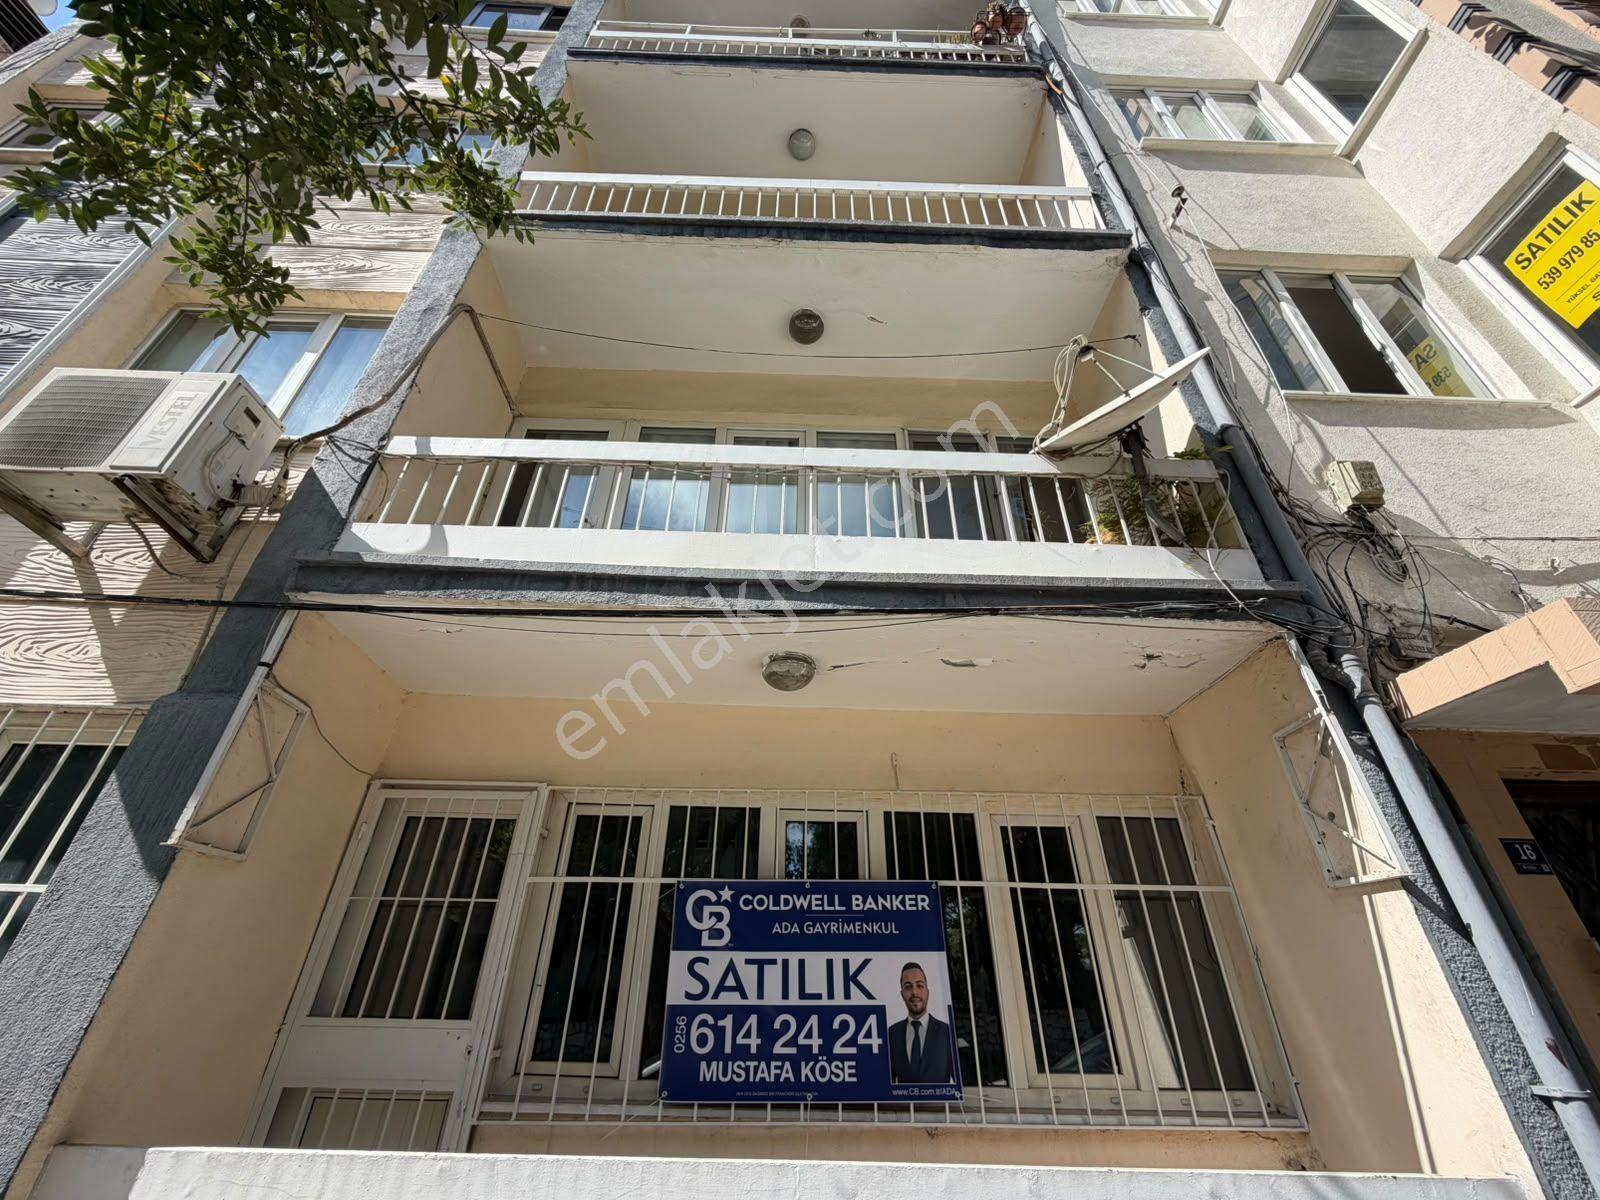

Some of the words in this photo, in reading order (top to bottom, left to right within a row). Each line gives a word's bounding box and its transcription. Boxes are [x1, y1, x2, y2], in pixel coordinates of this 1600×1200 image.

[1515, 191, 1595, 270] SATILIK
[1537, 266, 1562, 290] 539
[1558, 245, 1585, 270] 979
[1580, 229, 1600, 248] 85
[1566, 283, 1591, 303] YÜKSEL
[139, 393, 200, 447] VESTEL
[1514, 843, 1537, 860] 16
[738, 893, 846, 911] COLDWELL
[852, 894, 931, 911] BANKER
[772, 922, 801, 935] ADA
[803, 918, 900, 935] GAYRİMENKUL
[684, 956, 878, 1001] SATILIK
[673, 1015, 687, 1053] 0256
[690, 1013, 762, 1054] 614
[772, 1013, 823, 1054] 24
[832, 1013, 884, 1054] 24
[699, 1061, 795, 1083] MUSTAFA
[801, 1055, 858, 1083] KÖSE
